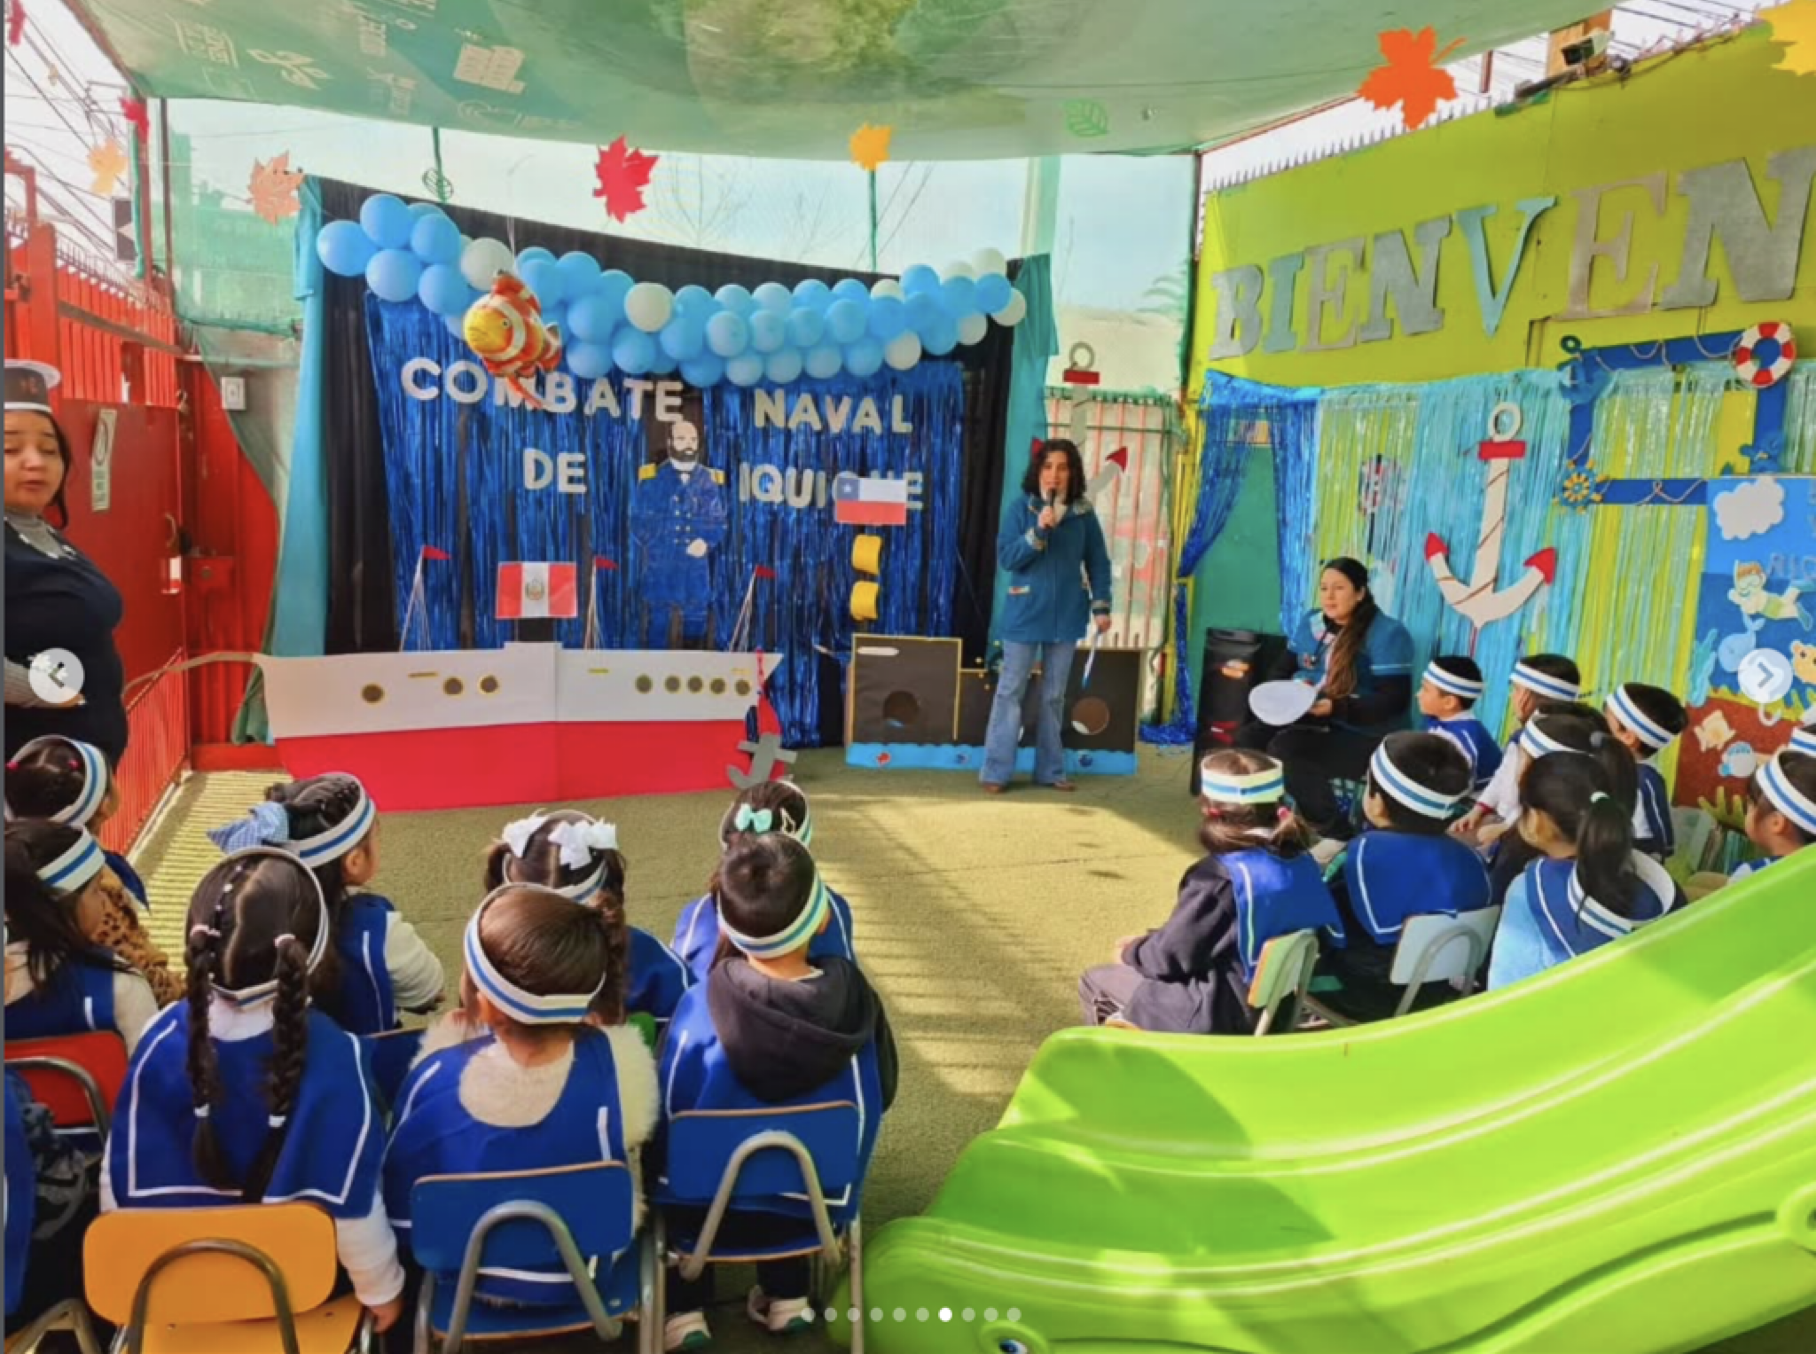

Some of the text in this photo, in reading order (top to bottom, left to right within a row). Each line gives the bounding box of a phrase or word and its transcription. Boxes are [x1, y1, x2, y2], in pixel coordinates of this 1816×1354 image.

[1209, 143, 1816, 360] BIENVEN
[400, 356, 913, 435] COMBATE NAVAL
[522, 447, 924, 511] DE IQUIE
